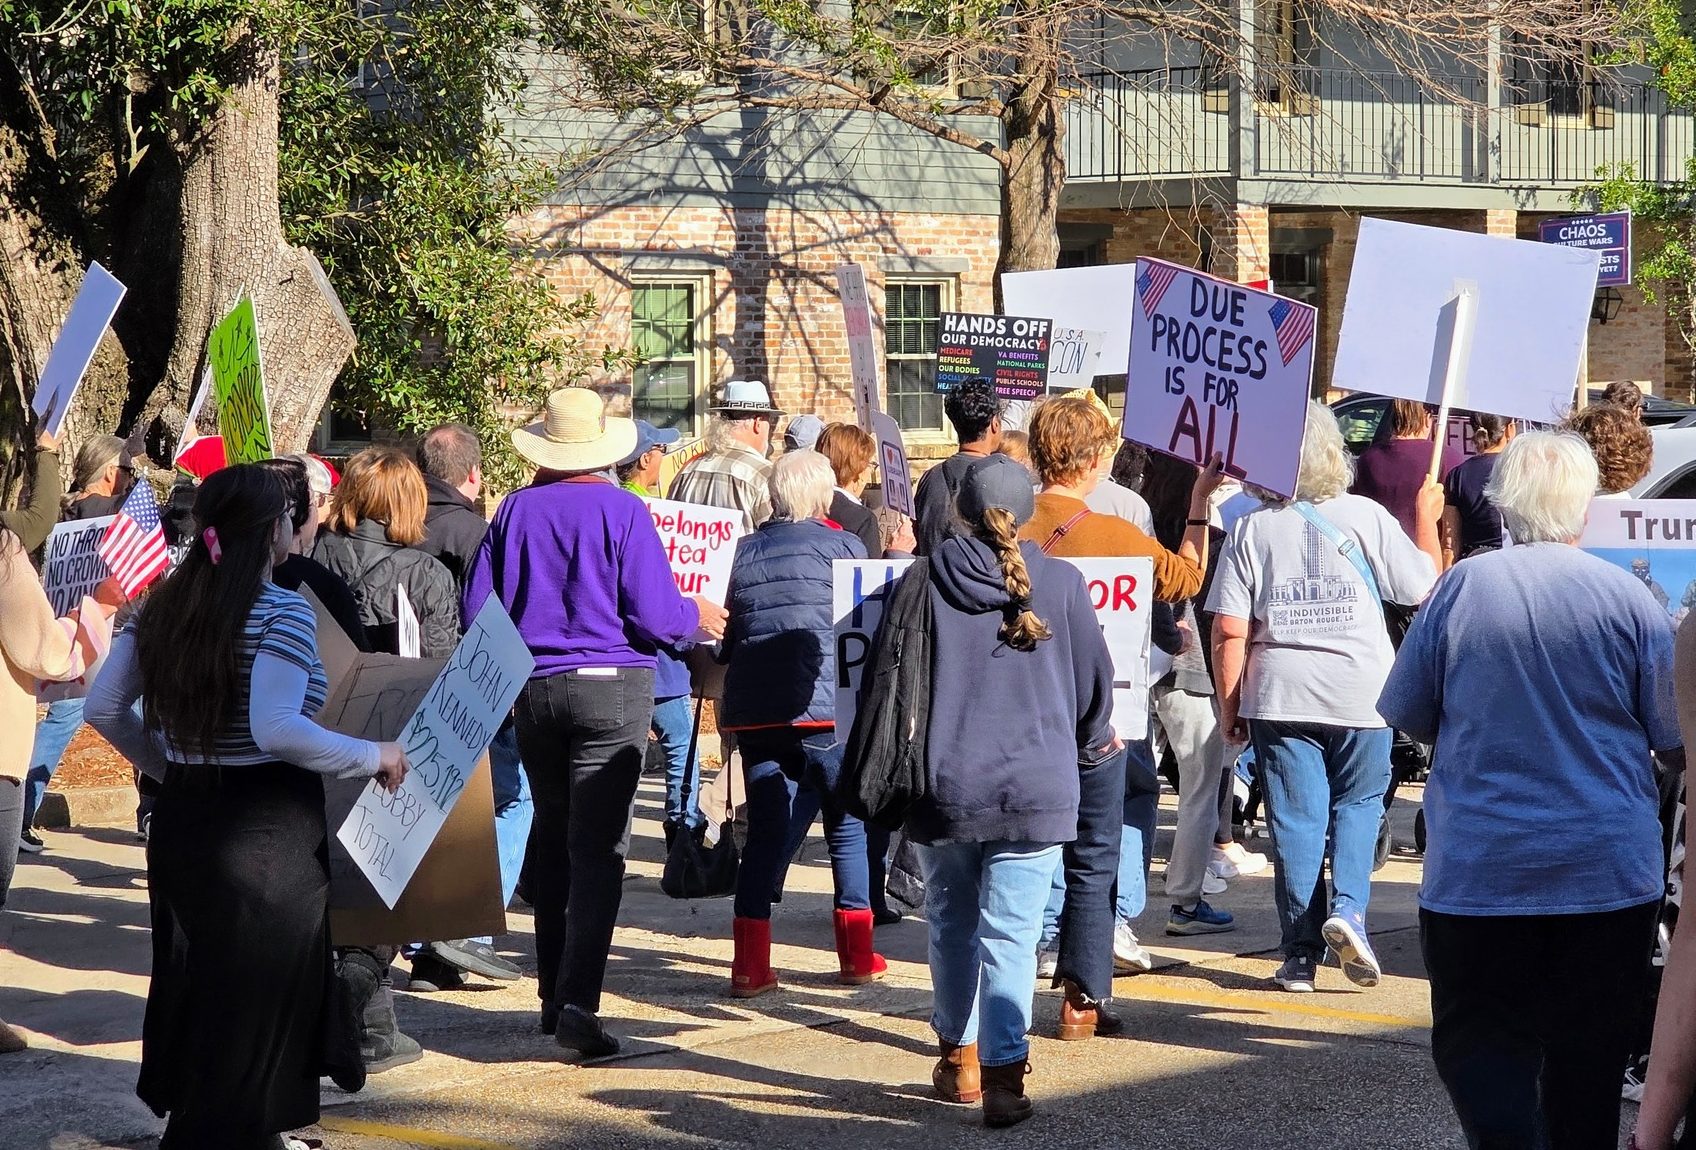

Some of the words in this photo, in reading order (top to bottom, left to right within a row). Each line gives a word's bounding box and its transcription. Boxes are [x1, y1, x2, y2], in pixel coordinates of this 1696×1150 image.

[1560, 224, 1606, 240] CHAOS
[1190, 276, 1247, 327] DUE
[941, 333, 967, 345] OUR
[970, 336, 1044, 351] DEMOCRACY
[944, 314, 1007, 335] HANDS
[1012, 318, 1049, 338] OFF
[940, 348, 972, 356] MEDICARE
[1151, 313, 1268, 380] PROCESS
[1011, 388, 1036, 396] SPEECH
[1165, 365, 1186, 396] IS
[1203, 372, 1239, 412] FOR
[1168, 394, 1248, 479] ALL
[672, 449, 688, 473] NO
[51, 532, 70, 558] NO
[71, 526, 109, 555] THRO
[648, 503, 734, 551] belongs
[47, 559, 65, 588] NO
[65, 553, 113, 585] CROWN
[66, 582, 99, 617] KIN
[1289, 606, 1352, 616] INDIVISIBLE
[458, 621, 512, 713] JOHN
[431, 661, 492, 762] KENNEDY
[354, 804, 393, 882] TOTAL
